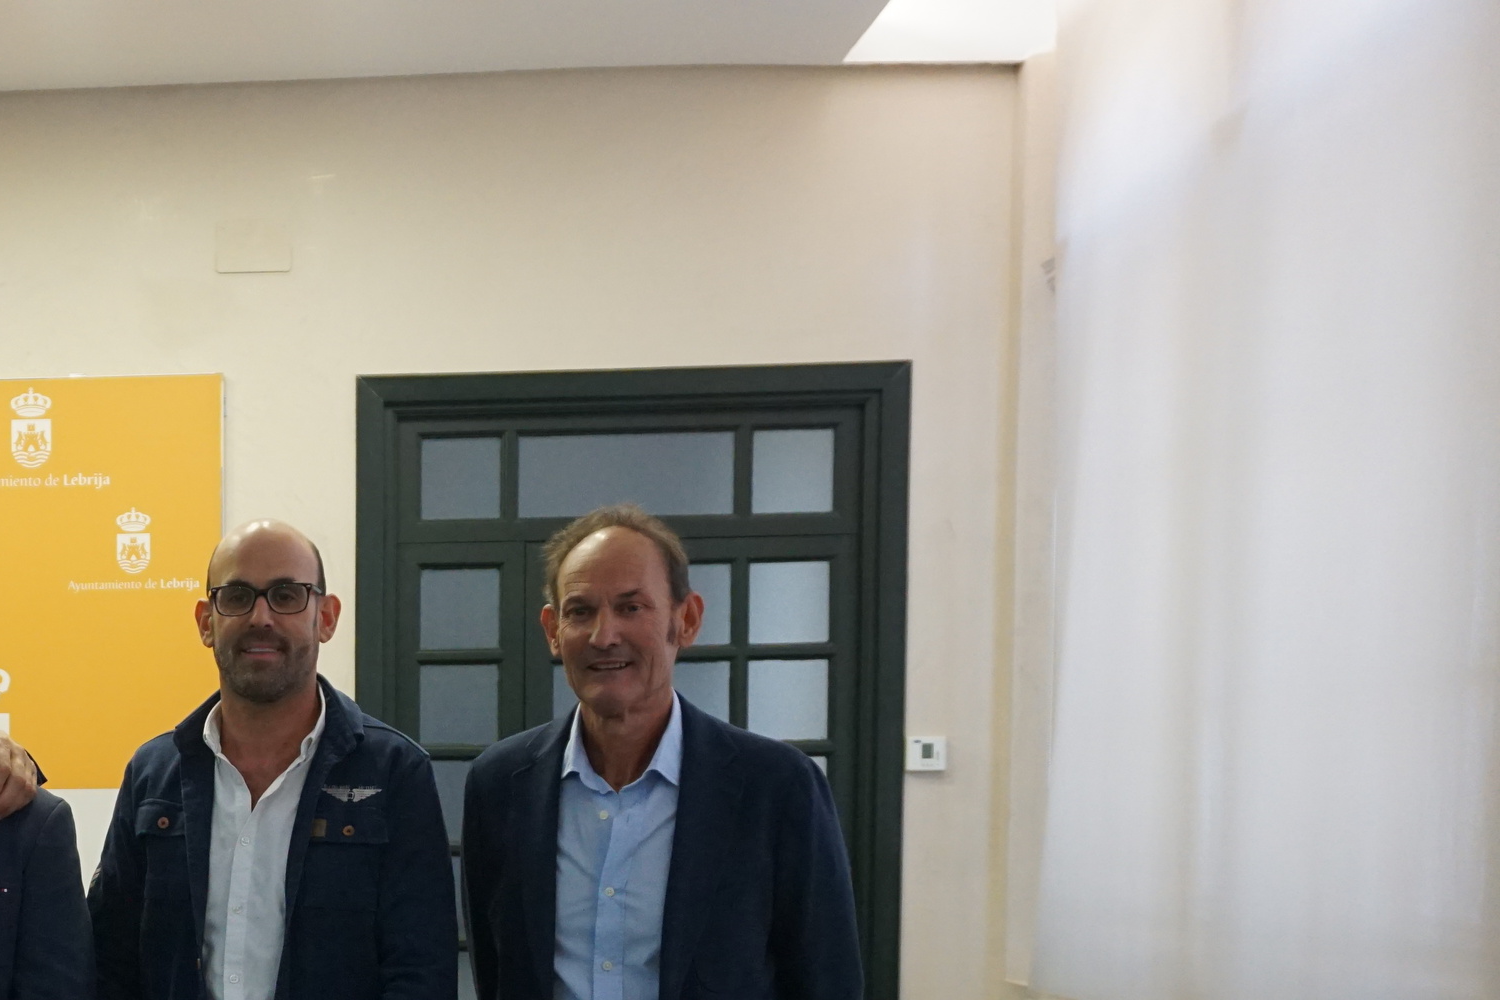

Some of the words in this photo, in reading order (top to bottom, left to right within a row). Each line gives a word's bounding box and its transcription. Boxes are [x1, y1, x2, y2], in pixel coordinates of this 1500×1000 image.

[45, 473, 60, 486] de
[63, 472, 111, 489] Lebrija
[68, 579, 142, 592] Ayuntamiento
[145, 578, 157, 589] de
[160, 577, 200, 591] Lebrija
